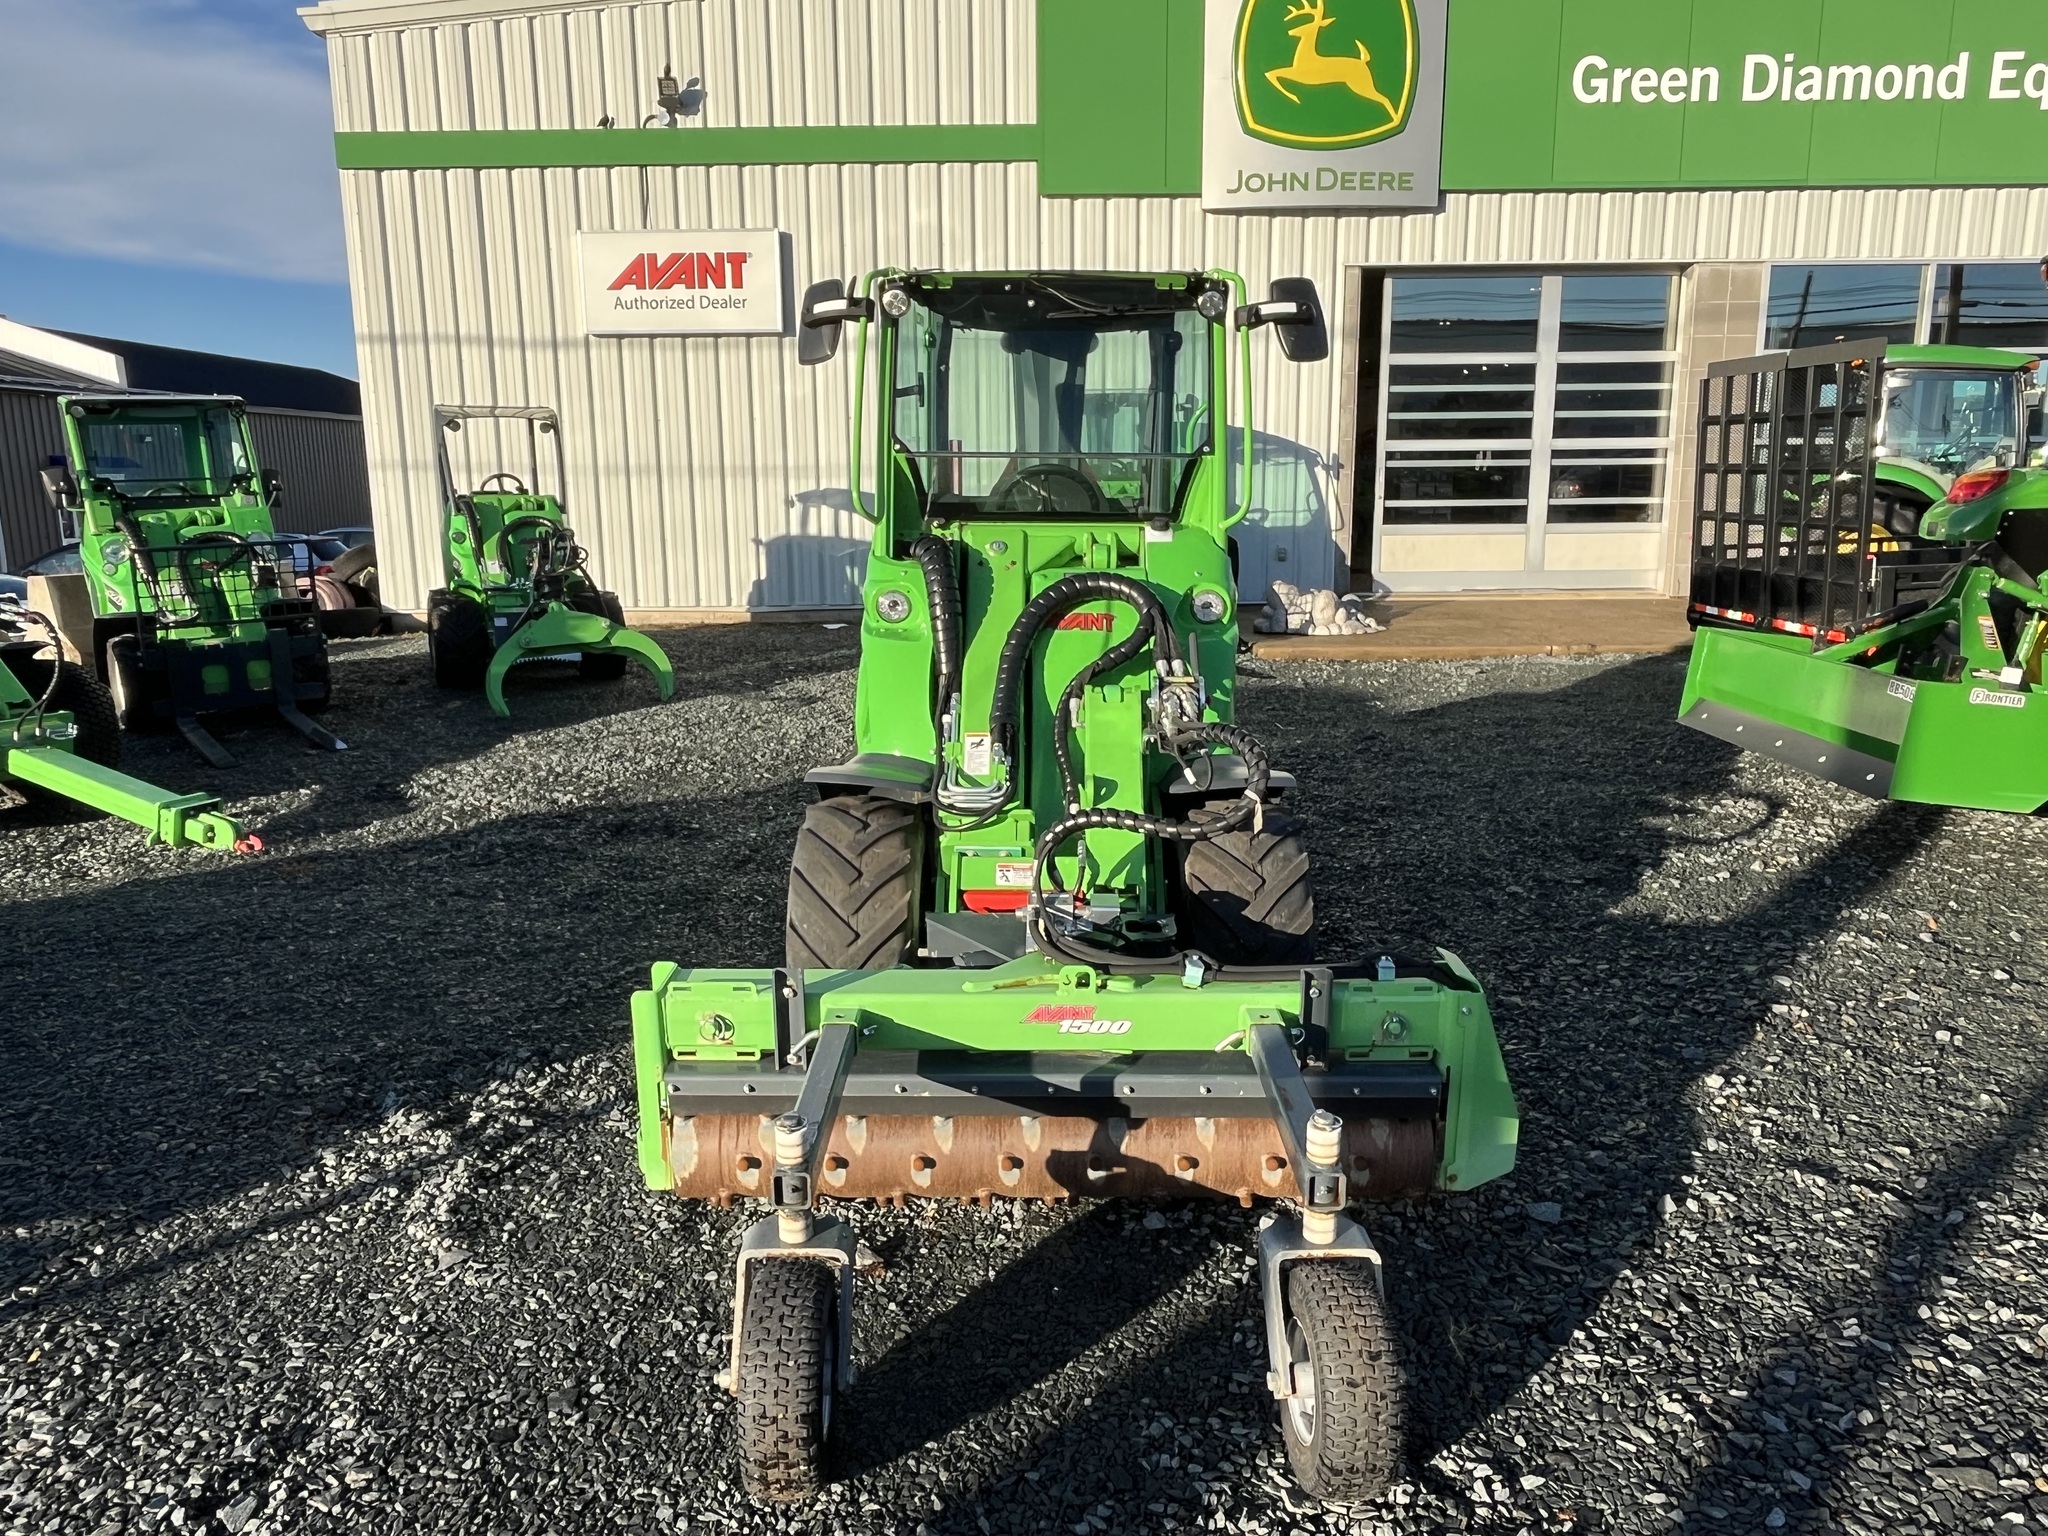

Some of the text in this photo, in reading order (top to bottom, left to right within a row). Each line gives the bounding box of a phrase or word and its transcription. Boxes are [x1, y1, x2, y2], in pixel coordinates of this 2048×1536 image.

[1572, 50, 2048, 111] Green Diamond Eq
[1226, 167, 1415, 194] JOHN DEERE
[606, 252, 748, 291] AVANT
[614, 294, 748, 311] Authorized Dealer
[1972, 689, 2023, 706] FRONTIER
[1020, 1004, 1097, 1024] AVANT
[1057, 1019, 1133, 1035] 1500
